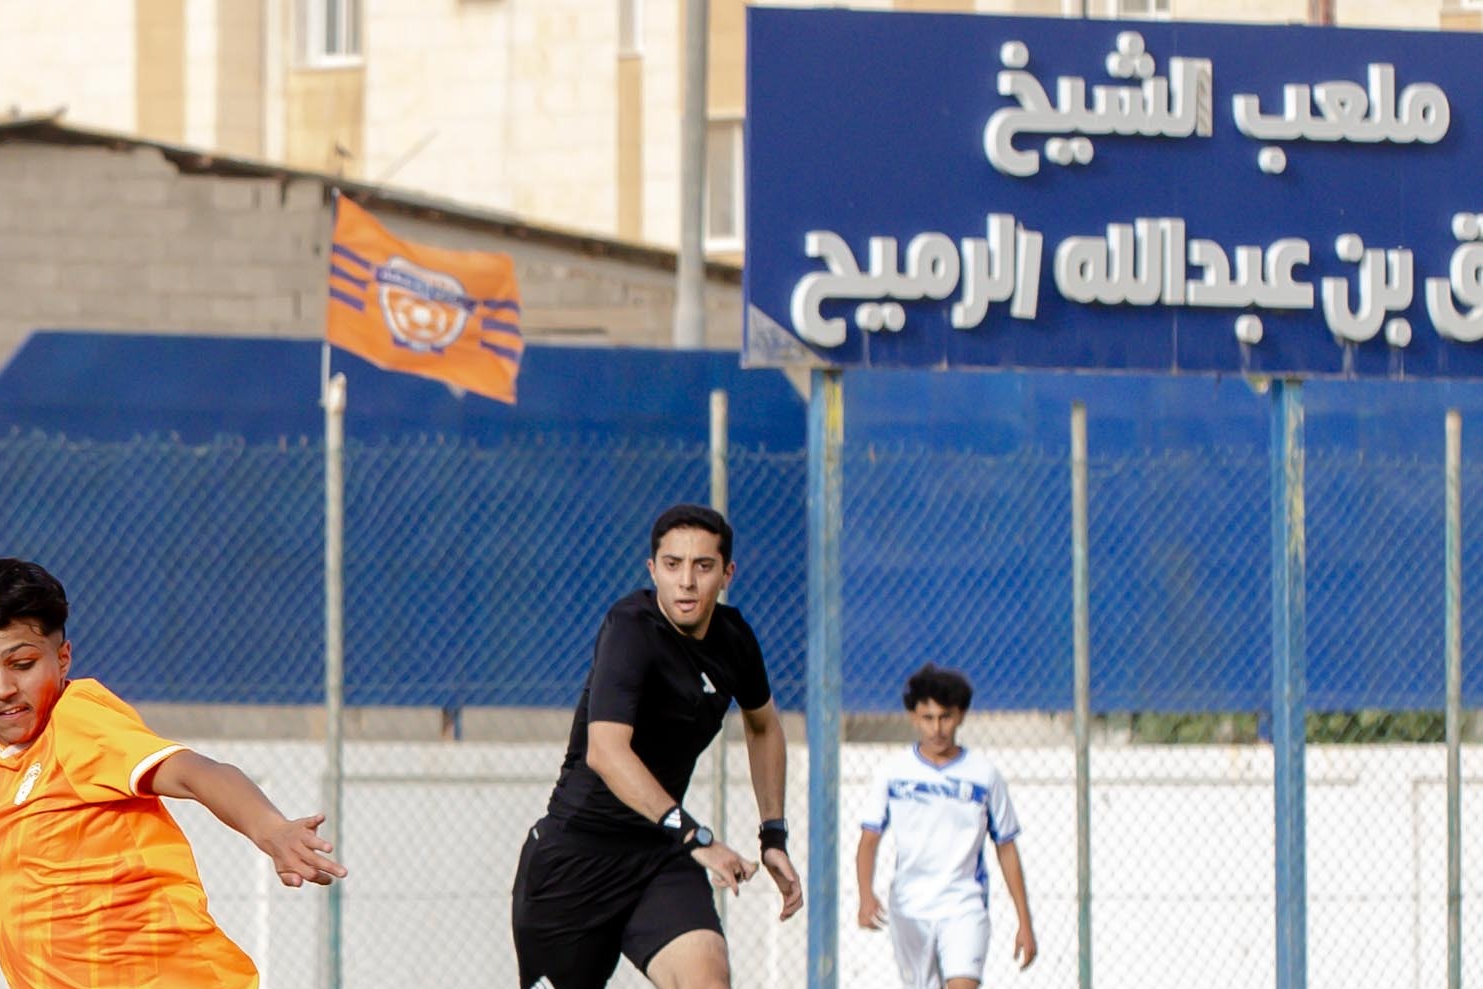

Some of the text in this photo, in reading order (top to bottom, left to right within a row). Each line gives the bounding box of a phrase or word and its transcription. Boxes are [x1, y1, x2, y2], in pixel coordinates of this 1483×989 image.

[983, 31, 1450, 177] ملعب الشيخ
[789, 212, 1044, 348] الرميح
[1322, 233, 1414, 347] بن
